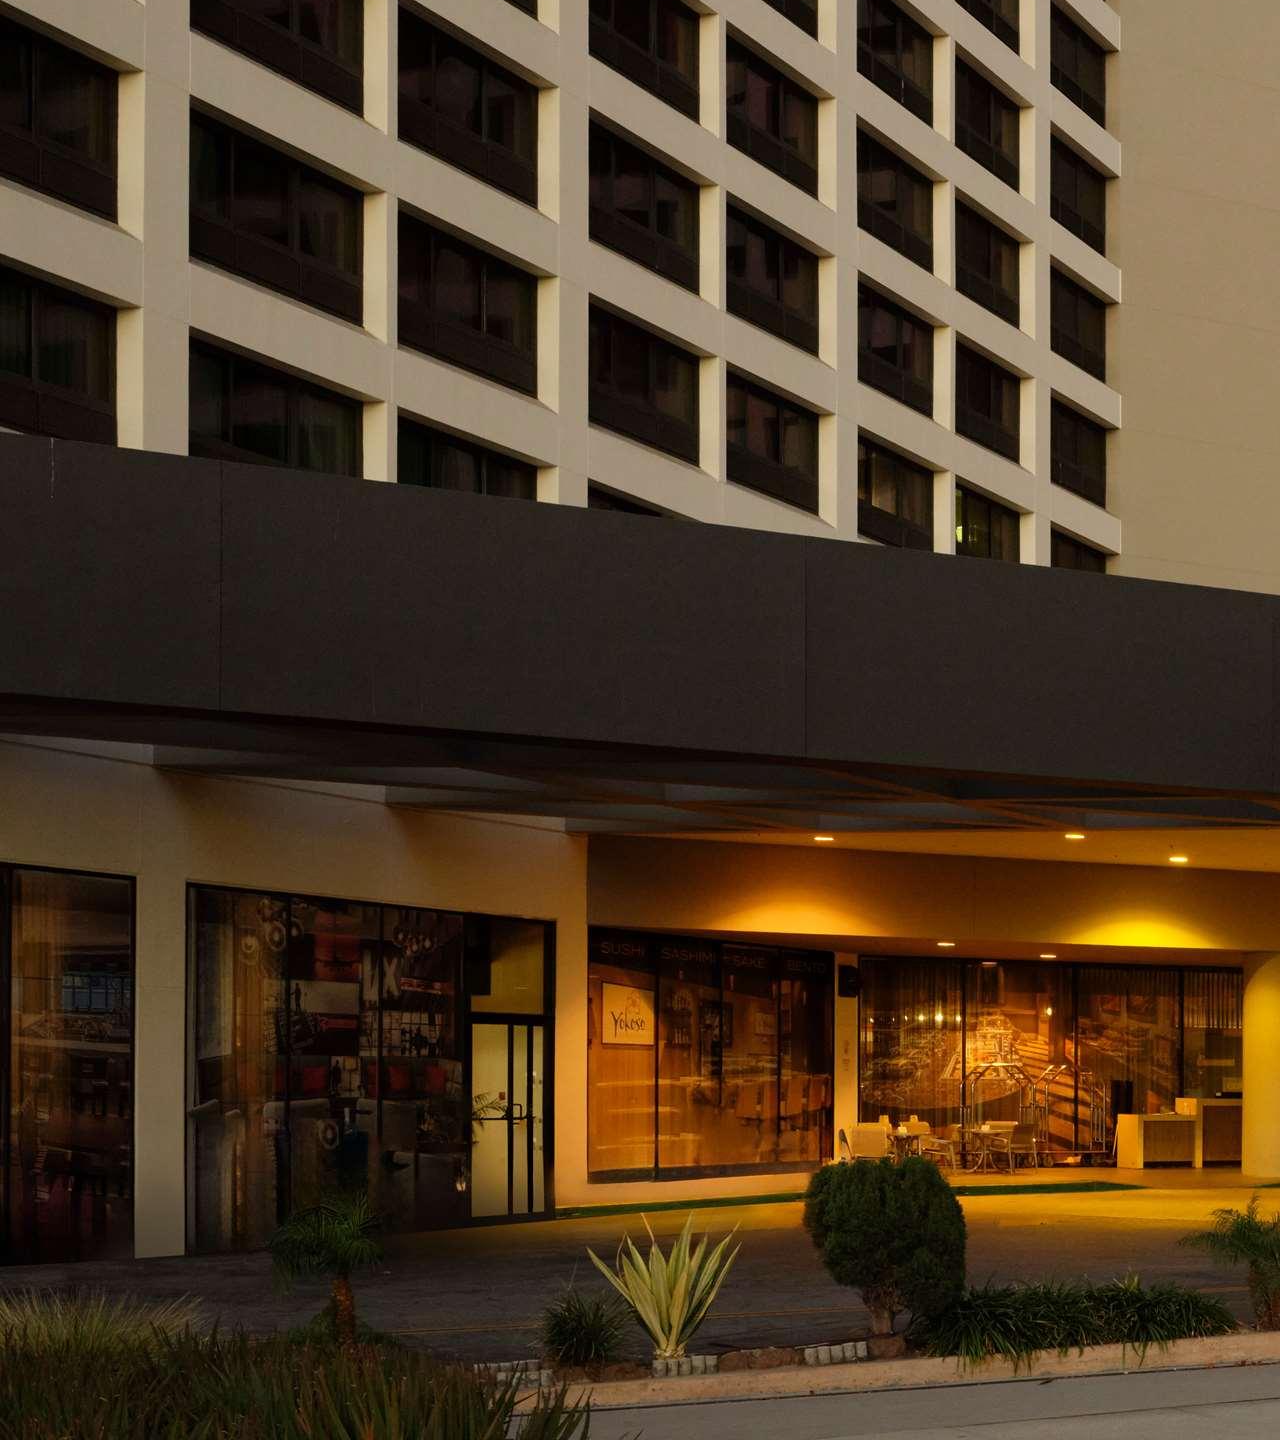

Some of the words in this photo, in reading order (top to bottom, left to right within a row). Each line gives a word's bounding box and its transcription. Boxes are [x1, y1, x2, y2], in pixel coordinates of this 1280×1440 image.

[599, 941, 645, 957] SUSHI
[661, 946, 716, 964] SASHIMI
[609, 1008, 646, 1039] Yokoso
